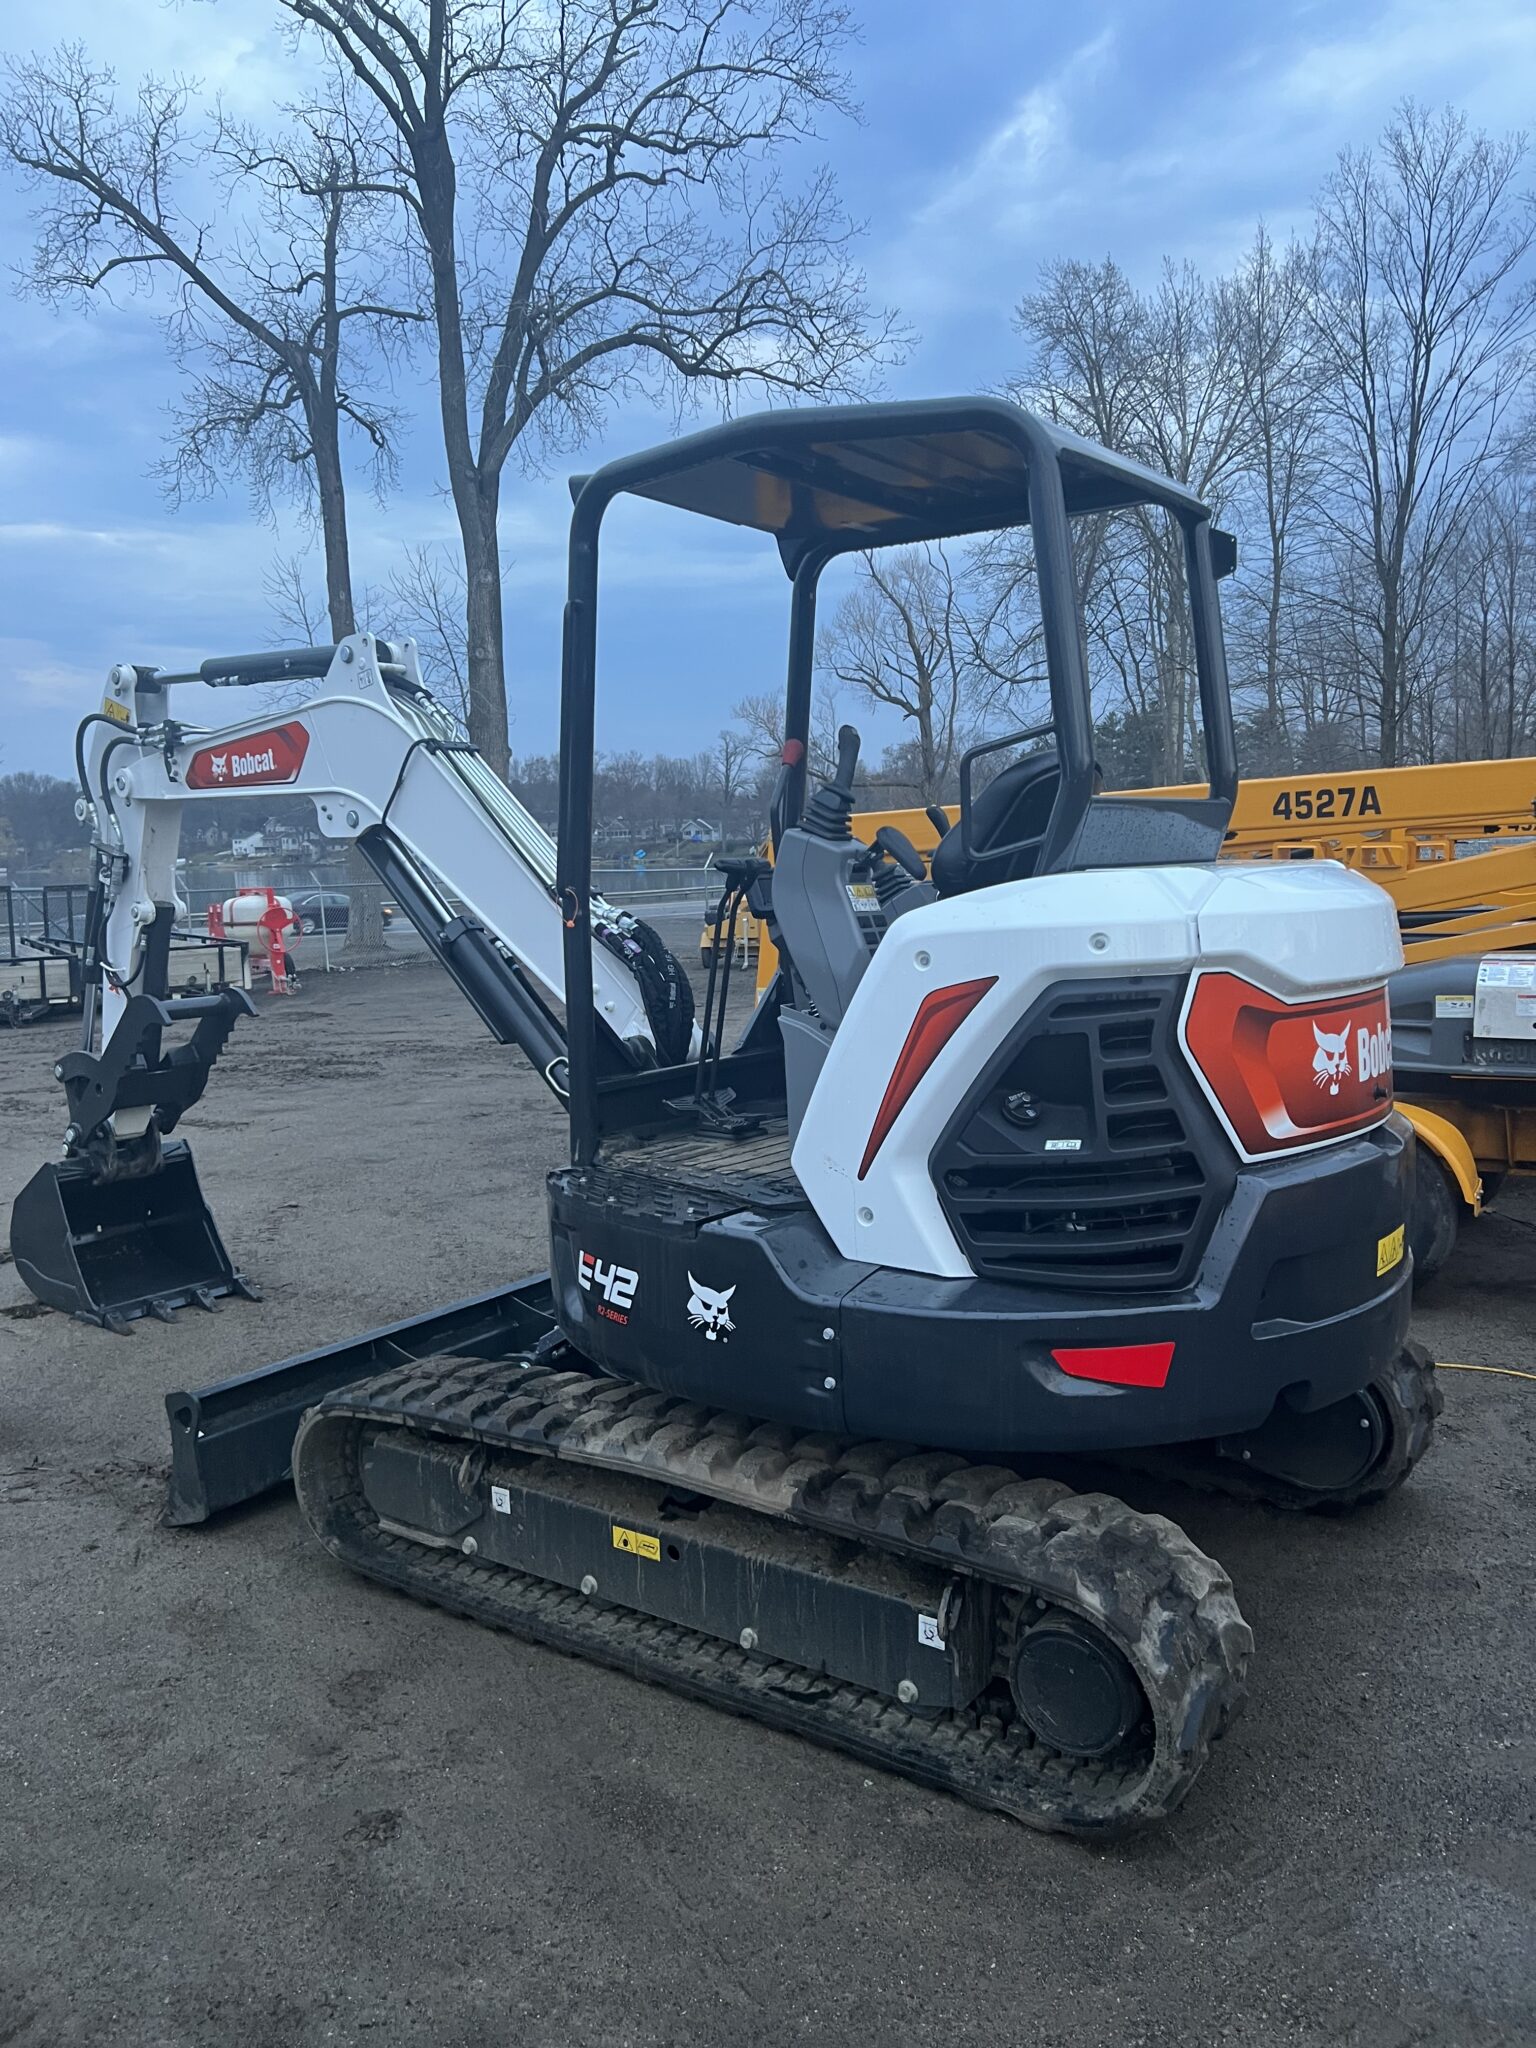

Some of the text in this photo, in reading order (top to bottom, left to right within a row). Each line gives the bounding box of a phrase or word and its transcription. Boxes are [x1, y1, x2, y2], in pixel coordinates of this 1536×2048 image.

[231, 748, 275, 777] Bobcat
[1272, 785, 1382, 820] 4527A
[1357, 1022, 1393, 1083] Bobc
[578, 1250, 639, 1309] E42
